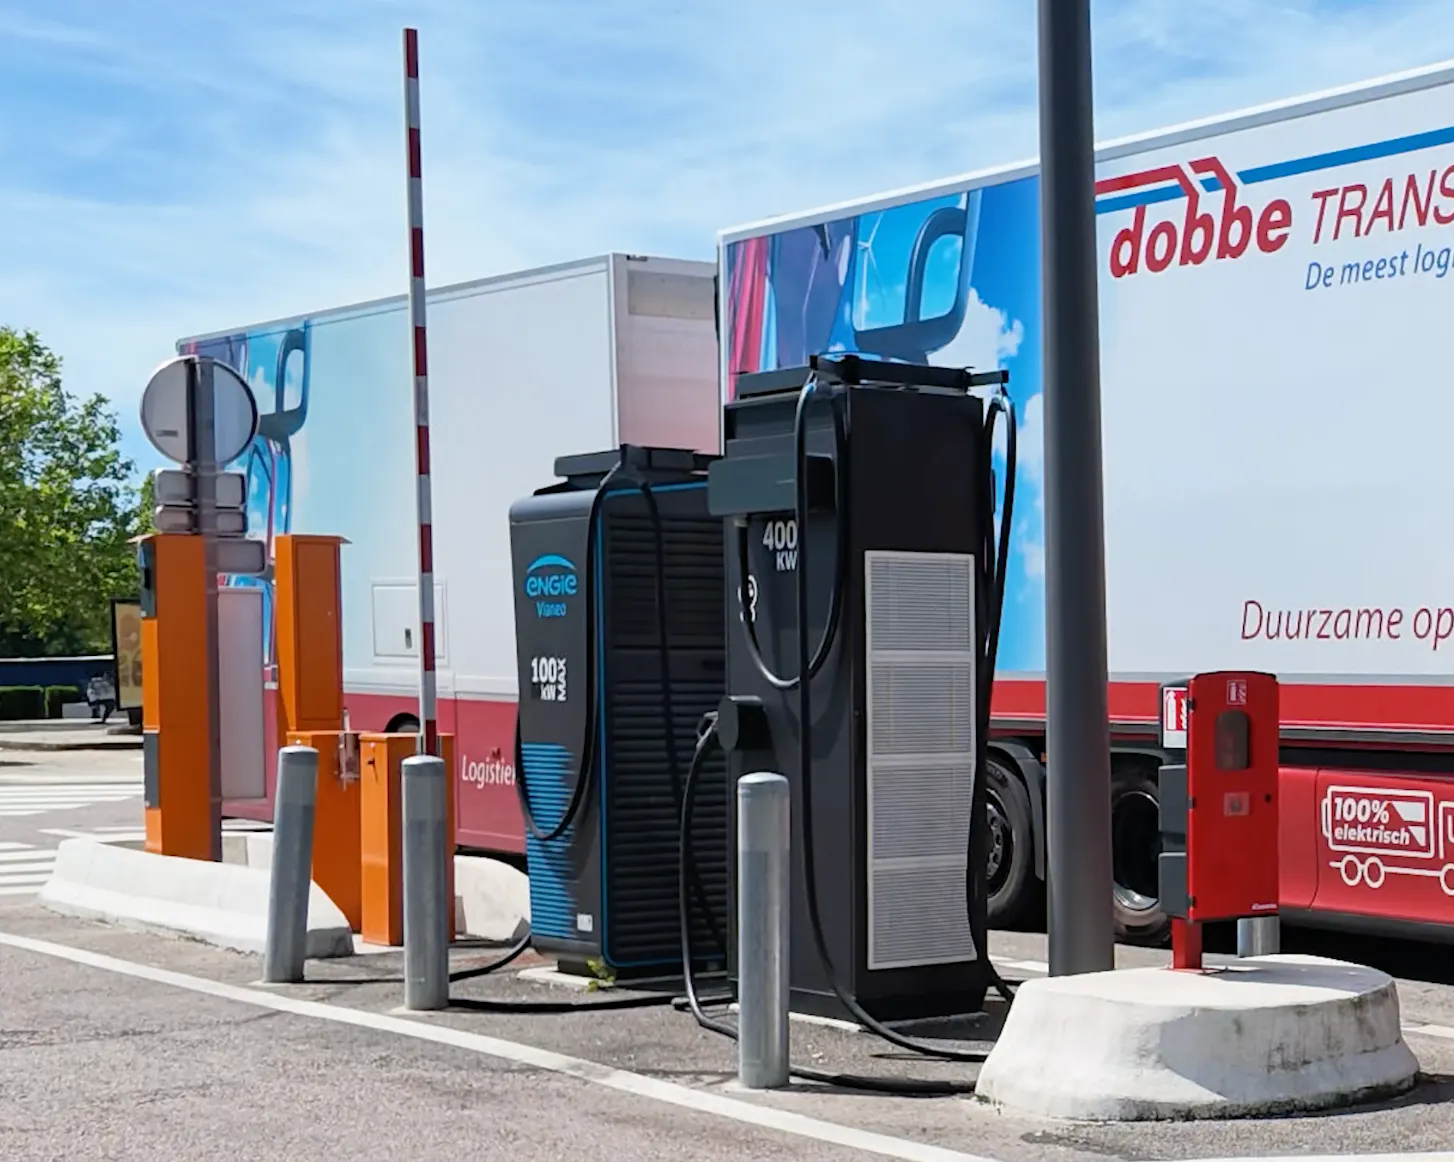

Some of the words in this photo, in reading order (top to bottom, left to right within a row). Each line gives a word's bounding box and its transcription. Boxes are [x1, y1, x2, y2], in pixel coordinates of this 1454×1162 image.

[1109, 172, 1293, 279] dobbe
[1305, 262, 1333, 291] De
[1340, 250, 1408, 285] meest
[762, 520, 798, 551] 400
[776, 550, 798, 571] KW
[1241, 600, 1404, 640] Duurzame
[531, 656, 557, 683] 100
[557, 658, 567, 701] MAX
[1333, 797, 1390, 824] 100%
[1334, 823, 1410, 846] elektrisch
